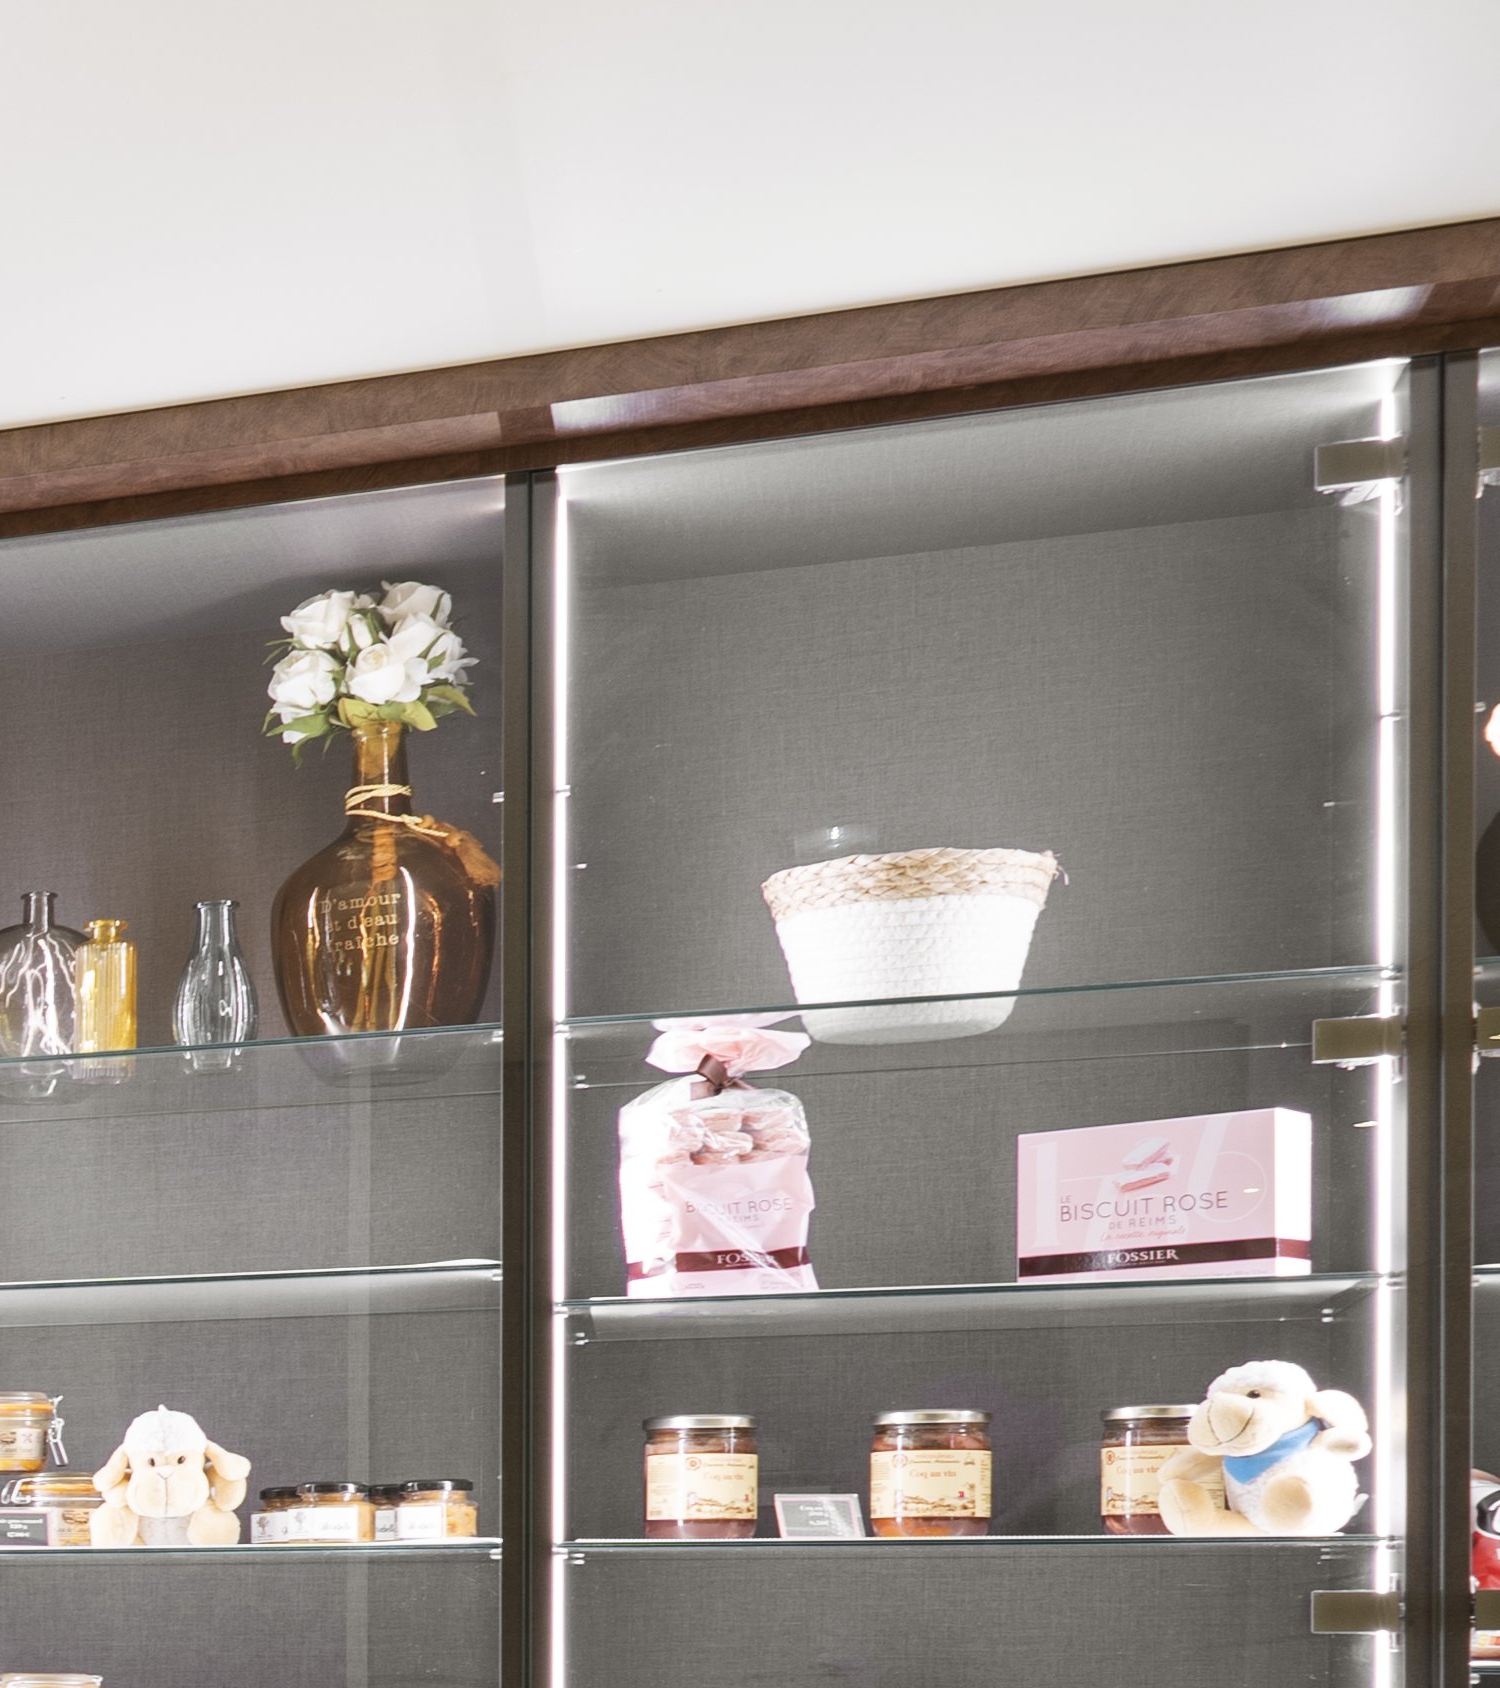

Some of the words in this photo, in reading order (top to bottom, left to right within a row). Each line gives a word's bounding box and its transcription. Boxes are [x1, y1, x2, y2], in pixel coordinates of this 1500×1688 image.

[748, 1197, 793, 1212] ROSE
[1060, 1198, 1153, 1222] BISCUIT
[1163, 1191, 1228, 1212] ROSE
[1109, 1221, 1123, 1230] DE
[1128, 1214, 1176, 1228] REIMS
[1108, 1249, 1180, 1264] FOSSIER
